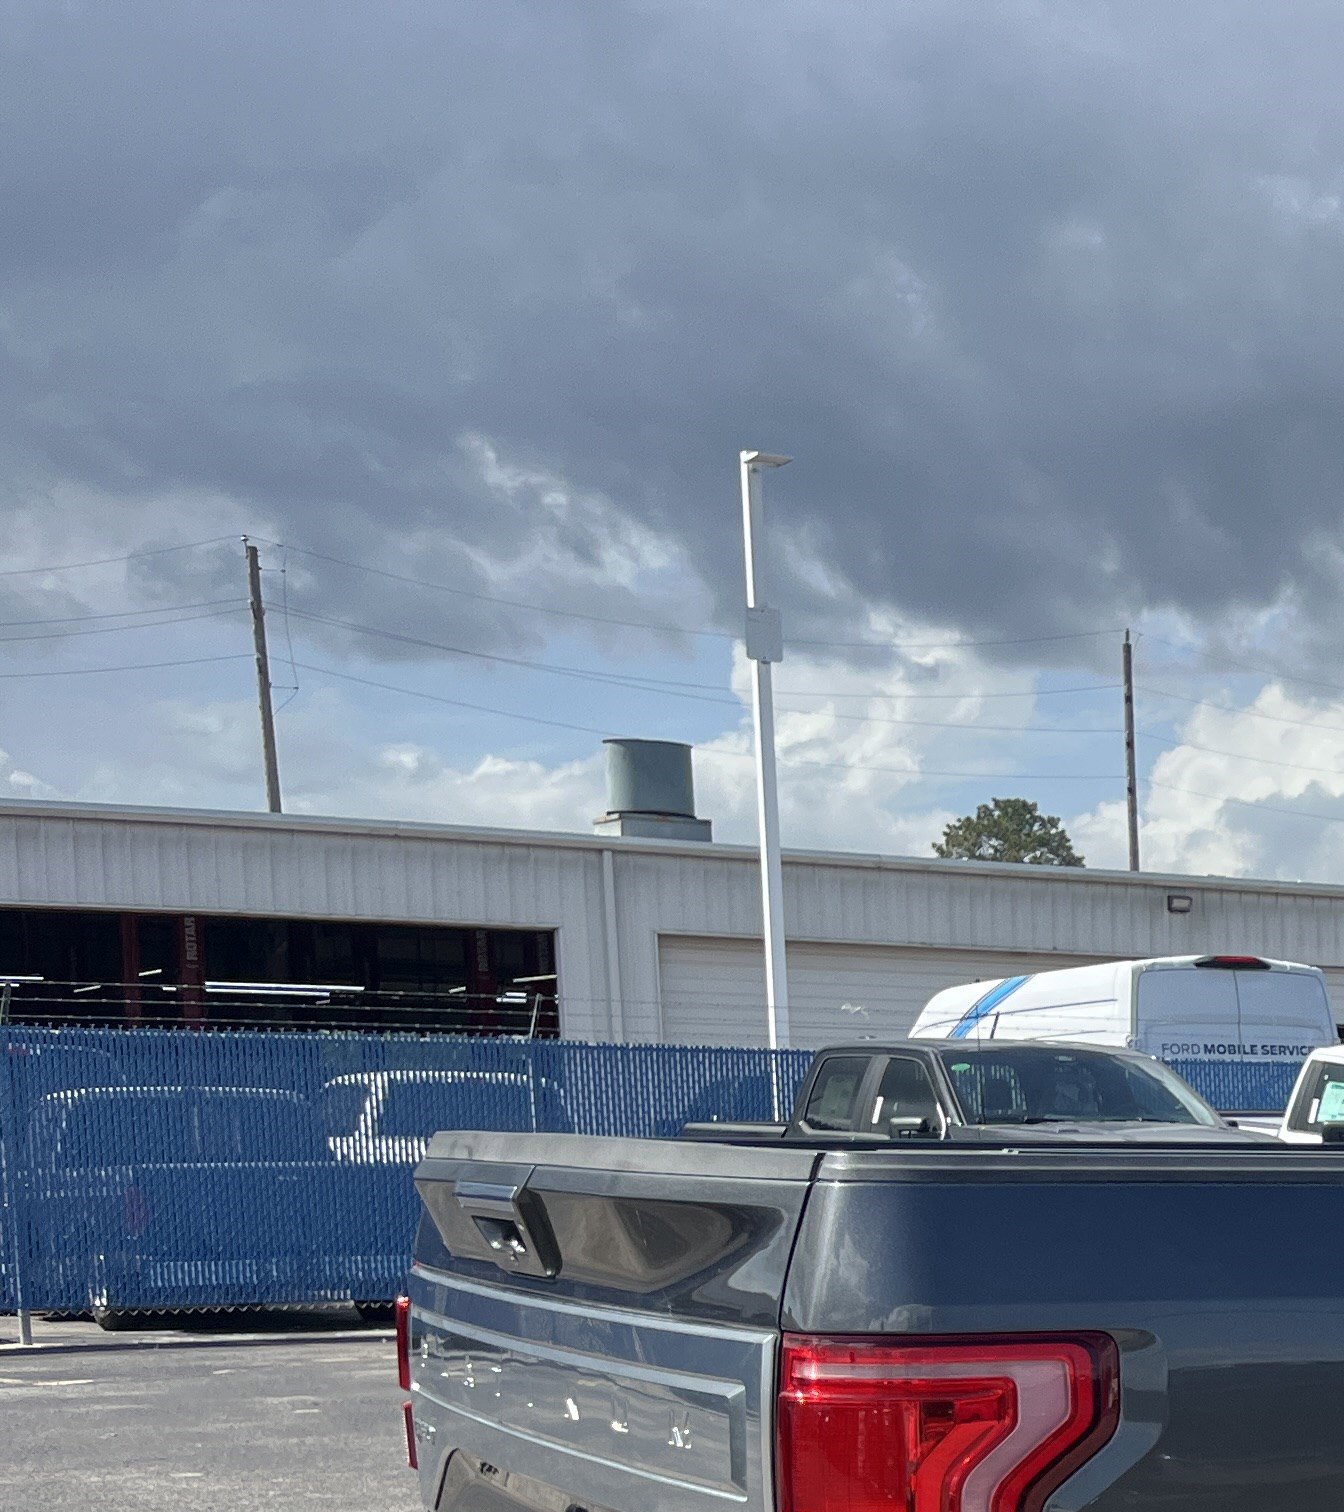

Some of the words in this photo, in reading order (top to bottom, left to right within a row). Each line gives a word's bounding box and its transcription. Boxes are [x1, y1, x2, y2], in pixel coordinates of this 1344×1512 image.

[1161, 1043, 1200, 1055] FORD
[1203, 1044, 1258, 1056] MOBILE
[1261, 1045, 1315, 1056] SERVICE
